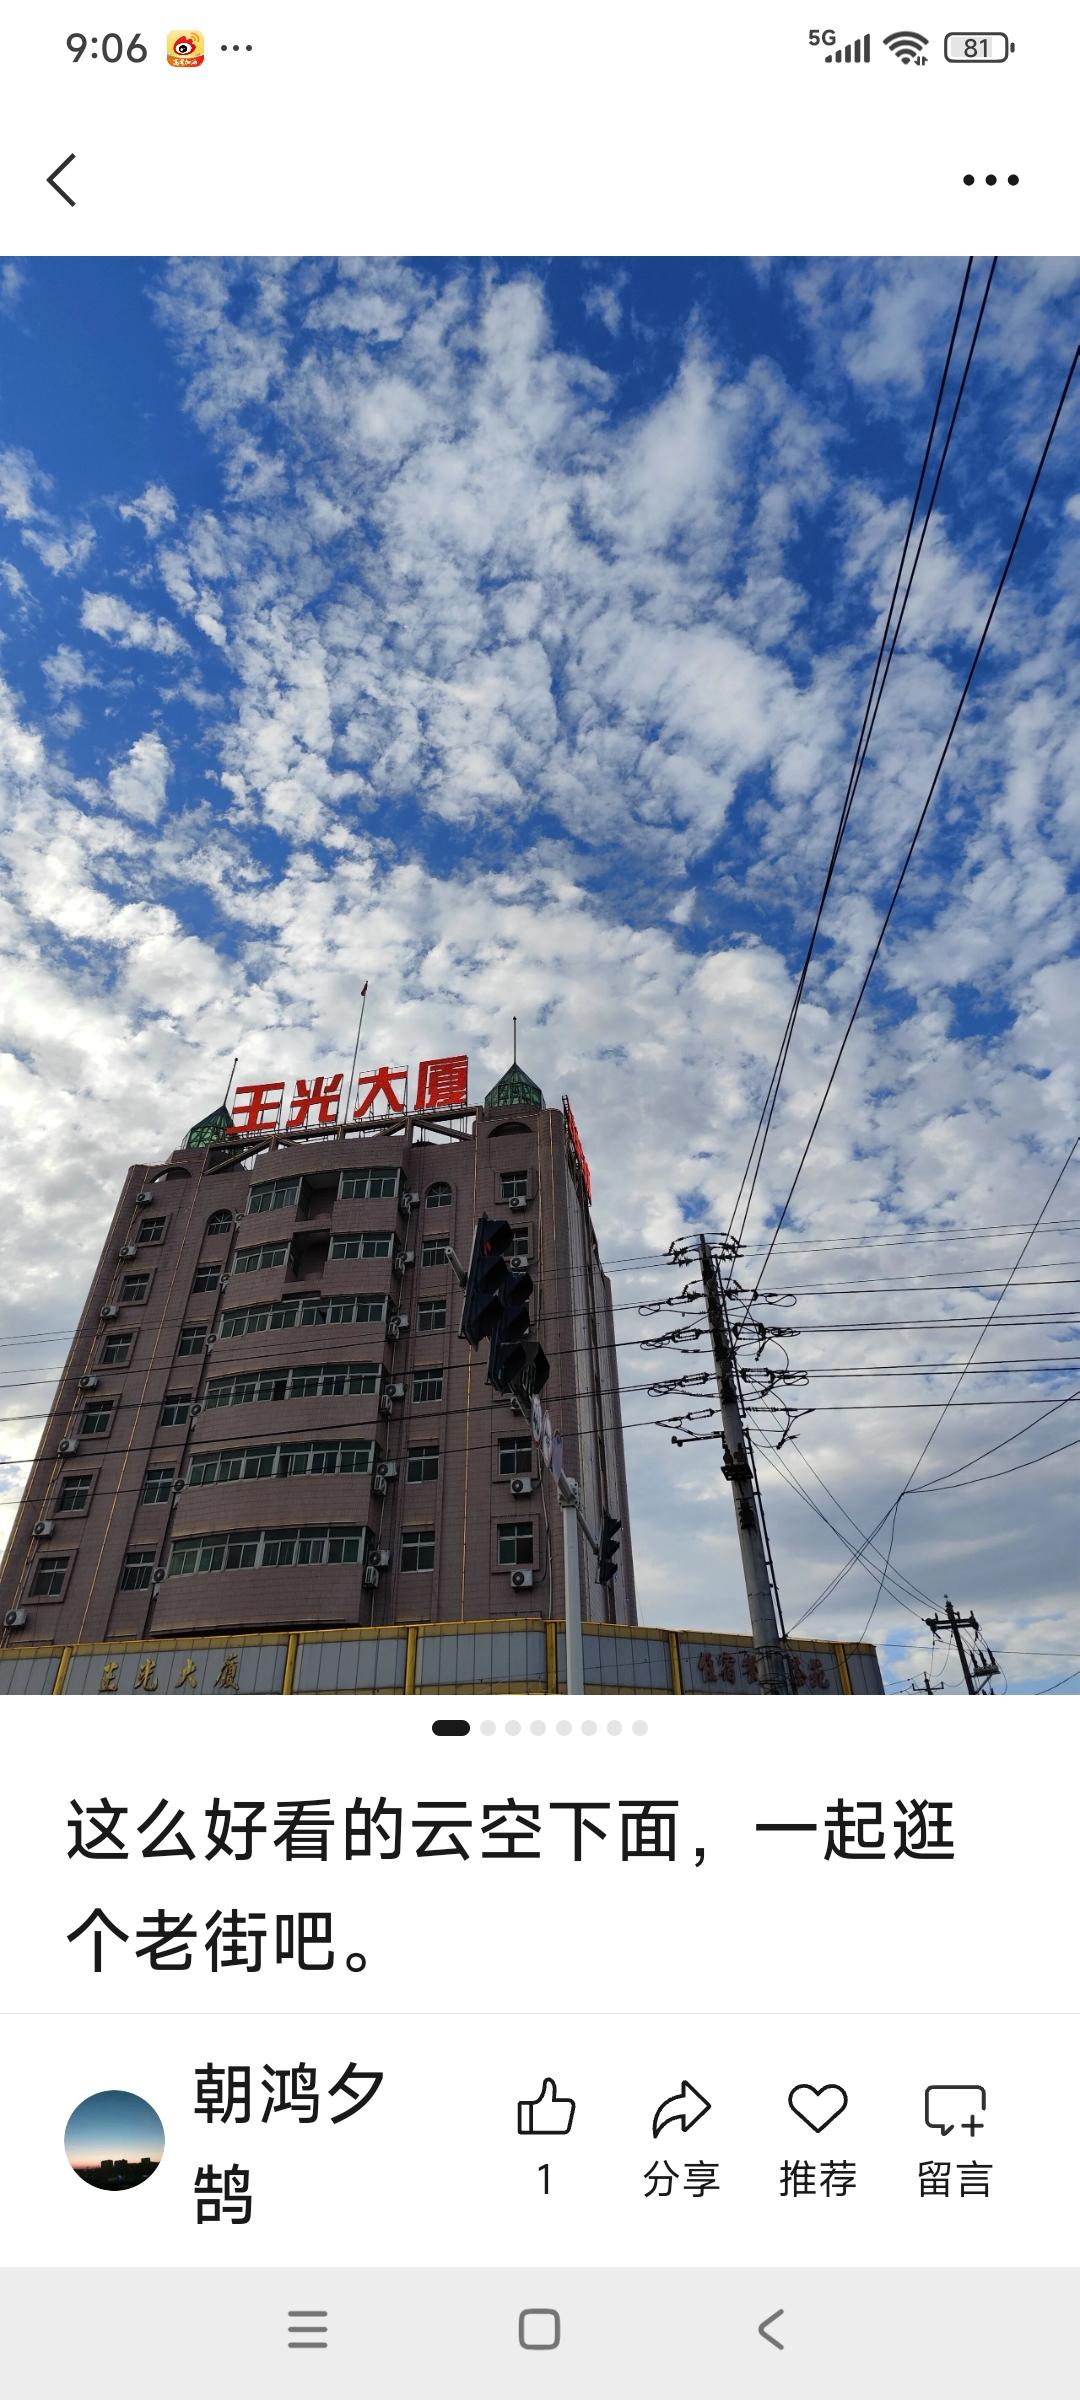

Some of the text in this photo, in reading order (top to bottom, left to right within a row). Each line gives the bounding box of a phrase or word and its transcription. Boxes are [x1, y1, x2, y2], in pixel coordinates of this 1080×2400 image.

[66, 33, 147, 63] 9:06
[809, 30, 836, 46] 5G
[964, 38, 988, 58] 81
[226, 1054, 469, 1136] 王光大厦
[67, 1797, 955, 1868] 这么好看的云空下面，一起逛
[67, 1907, 367, 1973] 个老街吧。
[194, 2061, 384, 2125] 朝鸿夕
[194, 2163, 252, 2225] 鹄
[538, 2163, 549, 2195] 1
[643, 2159, 720, 2198] 分享
[779, 2159, 857, 2198] 推荐
[918, 2159, 993, 2198] 留言
